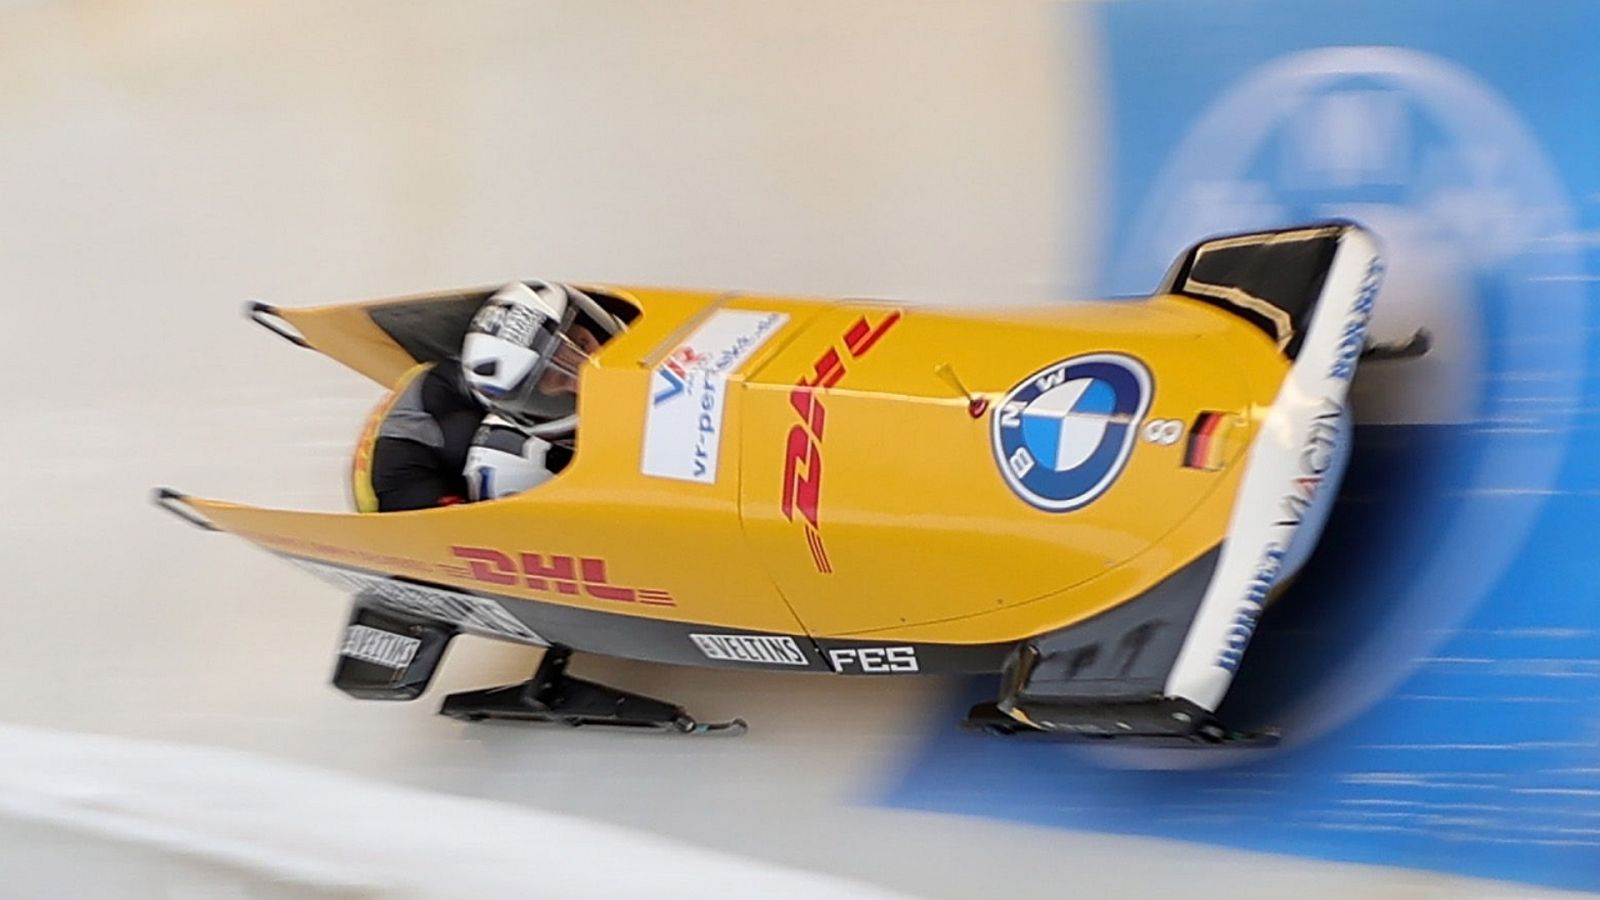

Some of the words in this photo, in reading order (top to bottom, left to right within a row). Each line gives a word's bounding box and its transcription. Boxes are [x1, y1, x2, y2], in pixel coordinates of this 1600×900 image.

[782, 309, 903, 531] DHL
[1001, 368, 1067, 479] BMW
[1142, 418, 1185, 446] 8
[1272, 397, 1345, 527] VIACTIV
[451, 545, 637, 603] DHL
[710, 635, 804, 665] VELTINS
[828, 645, 920, 673] FES
